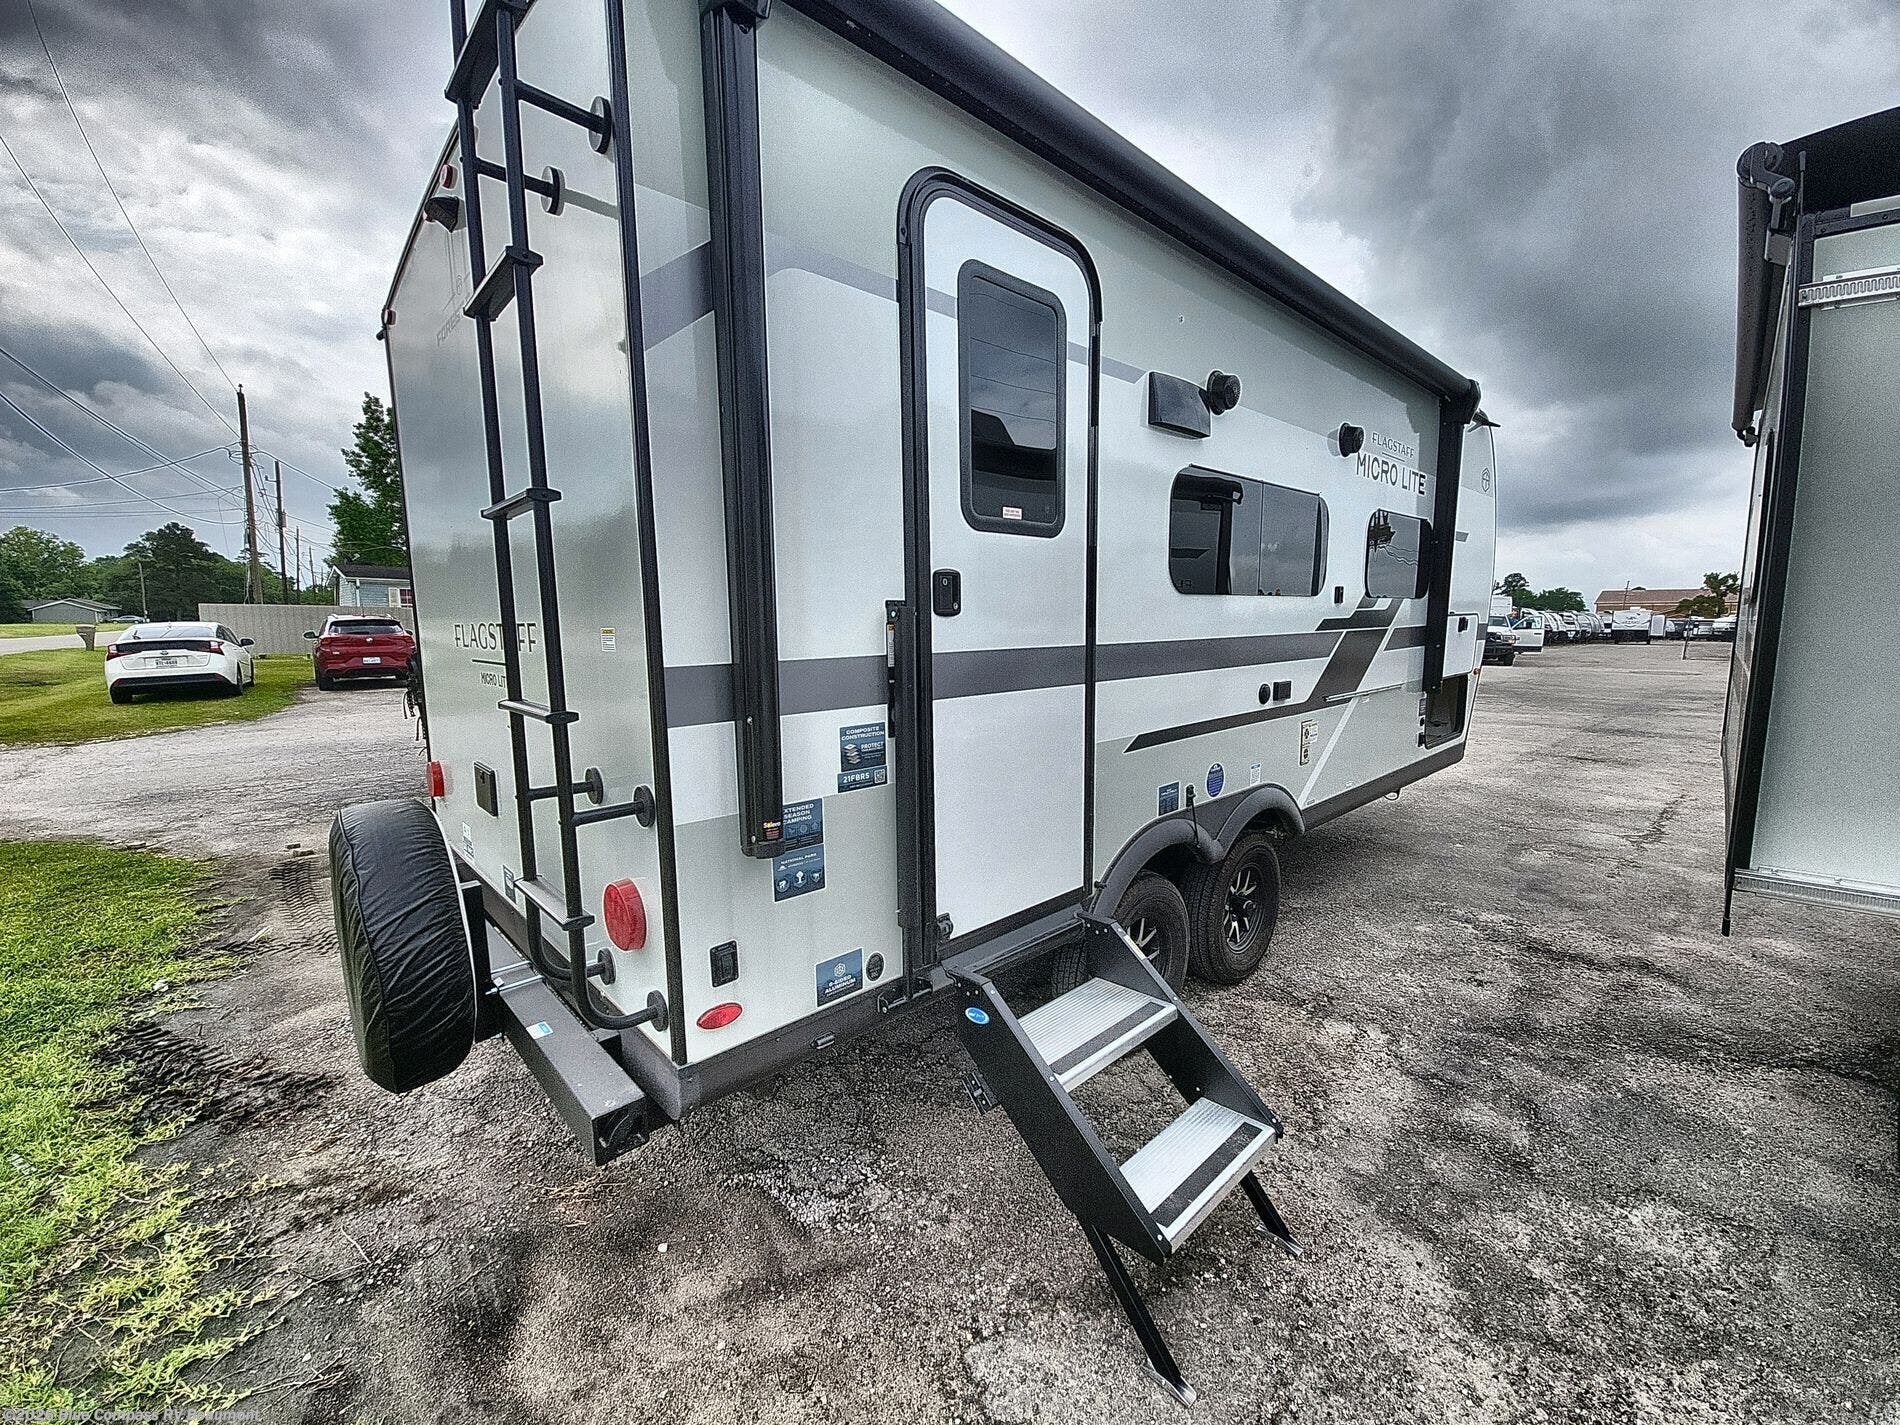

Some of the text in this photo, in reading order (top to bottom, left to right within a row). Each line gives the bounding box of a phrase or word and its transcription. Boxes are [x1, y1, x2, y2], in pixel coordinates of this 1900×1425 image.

[1372, 432, 1415, 458] FLAGSTAFF
[1356, 453, 1427, 496] MICRO LITE
[454, 622, 537, 652] FLAGSTFF
[480, 671, 498, 687] MICRO
[841, 731, 885, 741] CONSTRUCTION
[846, 726, 880, 735] COMPOSITE
[783, 803, 815, 814] XTENDED
[783, 810, 811, 819] SEASON
